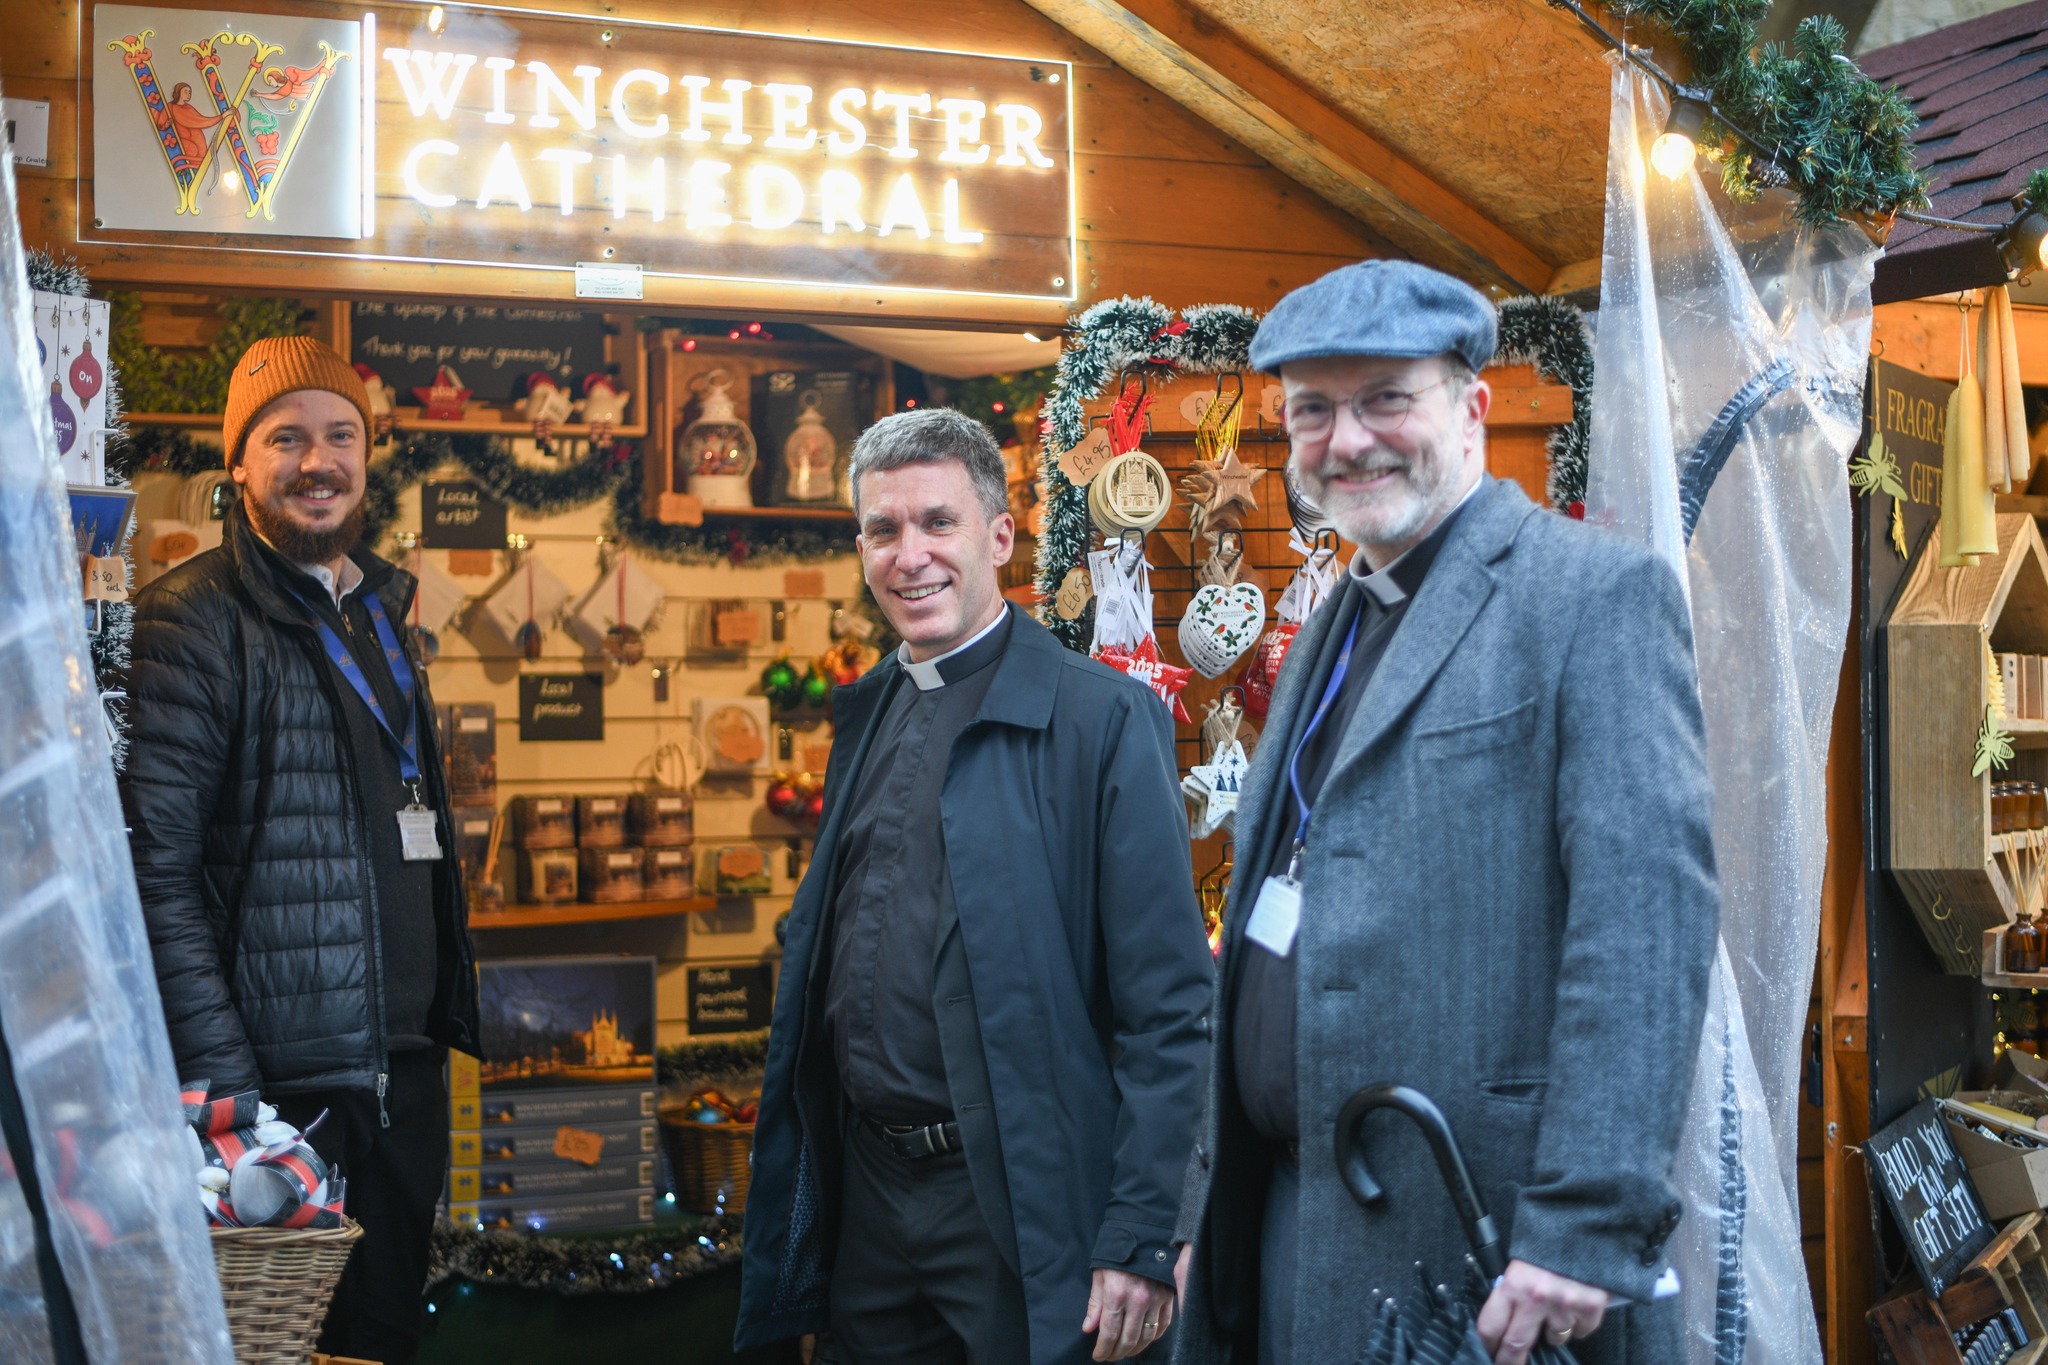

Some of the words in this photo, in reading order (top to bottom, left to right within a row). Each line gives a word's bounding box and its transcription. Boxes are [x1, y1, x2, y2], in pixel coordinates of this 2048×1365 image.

[382, 47, 1055, 169] WINCHESTER
[402, 139, 984, 244] CATHEDRAL
[362, 334, 404, 358] Thank
[406, 344, 436, 364] you
[458, 346, 493, 364] your
[78, 370, 93, 385] On
[53, 416, 73, 431] tmas
[1886, 387, 1944, 446] FRAGRA
[1072, 440, 1111, 476] £4.95
[437, 487, 480, 507] Local
[435, 508, 481, 526] artist
[105, 582, 122, 593] each
[1062, 574, 1092, 613] £6.50
[1126, 659, 1163, 679] 2025
[1876, 1136, 1922, 1200] BUILD
[1916, 1117, 1955, 1175] YOUR
[1918, 1159, 1948, 1207] OWN
[1913, 1206, 1952, 1262] GIFT
[1942, 1177, 1983, 1241] SET!
